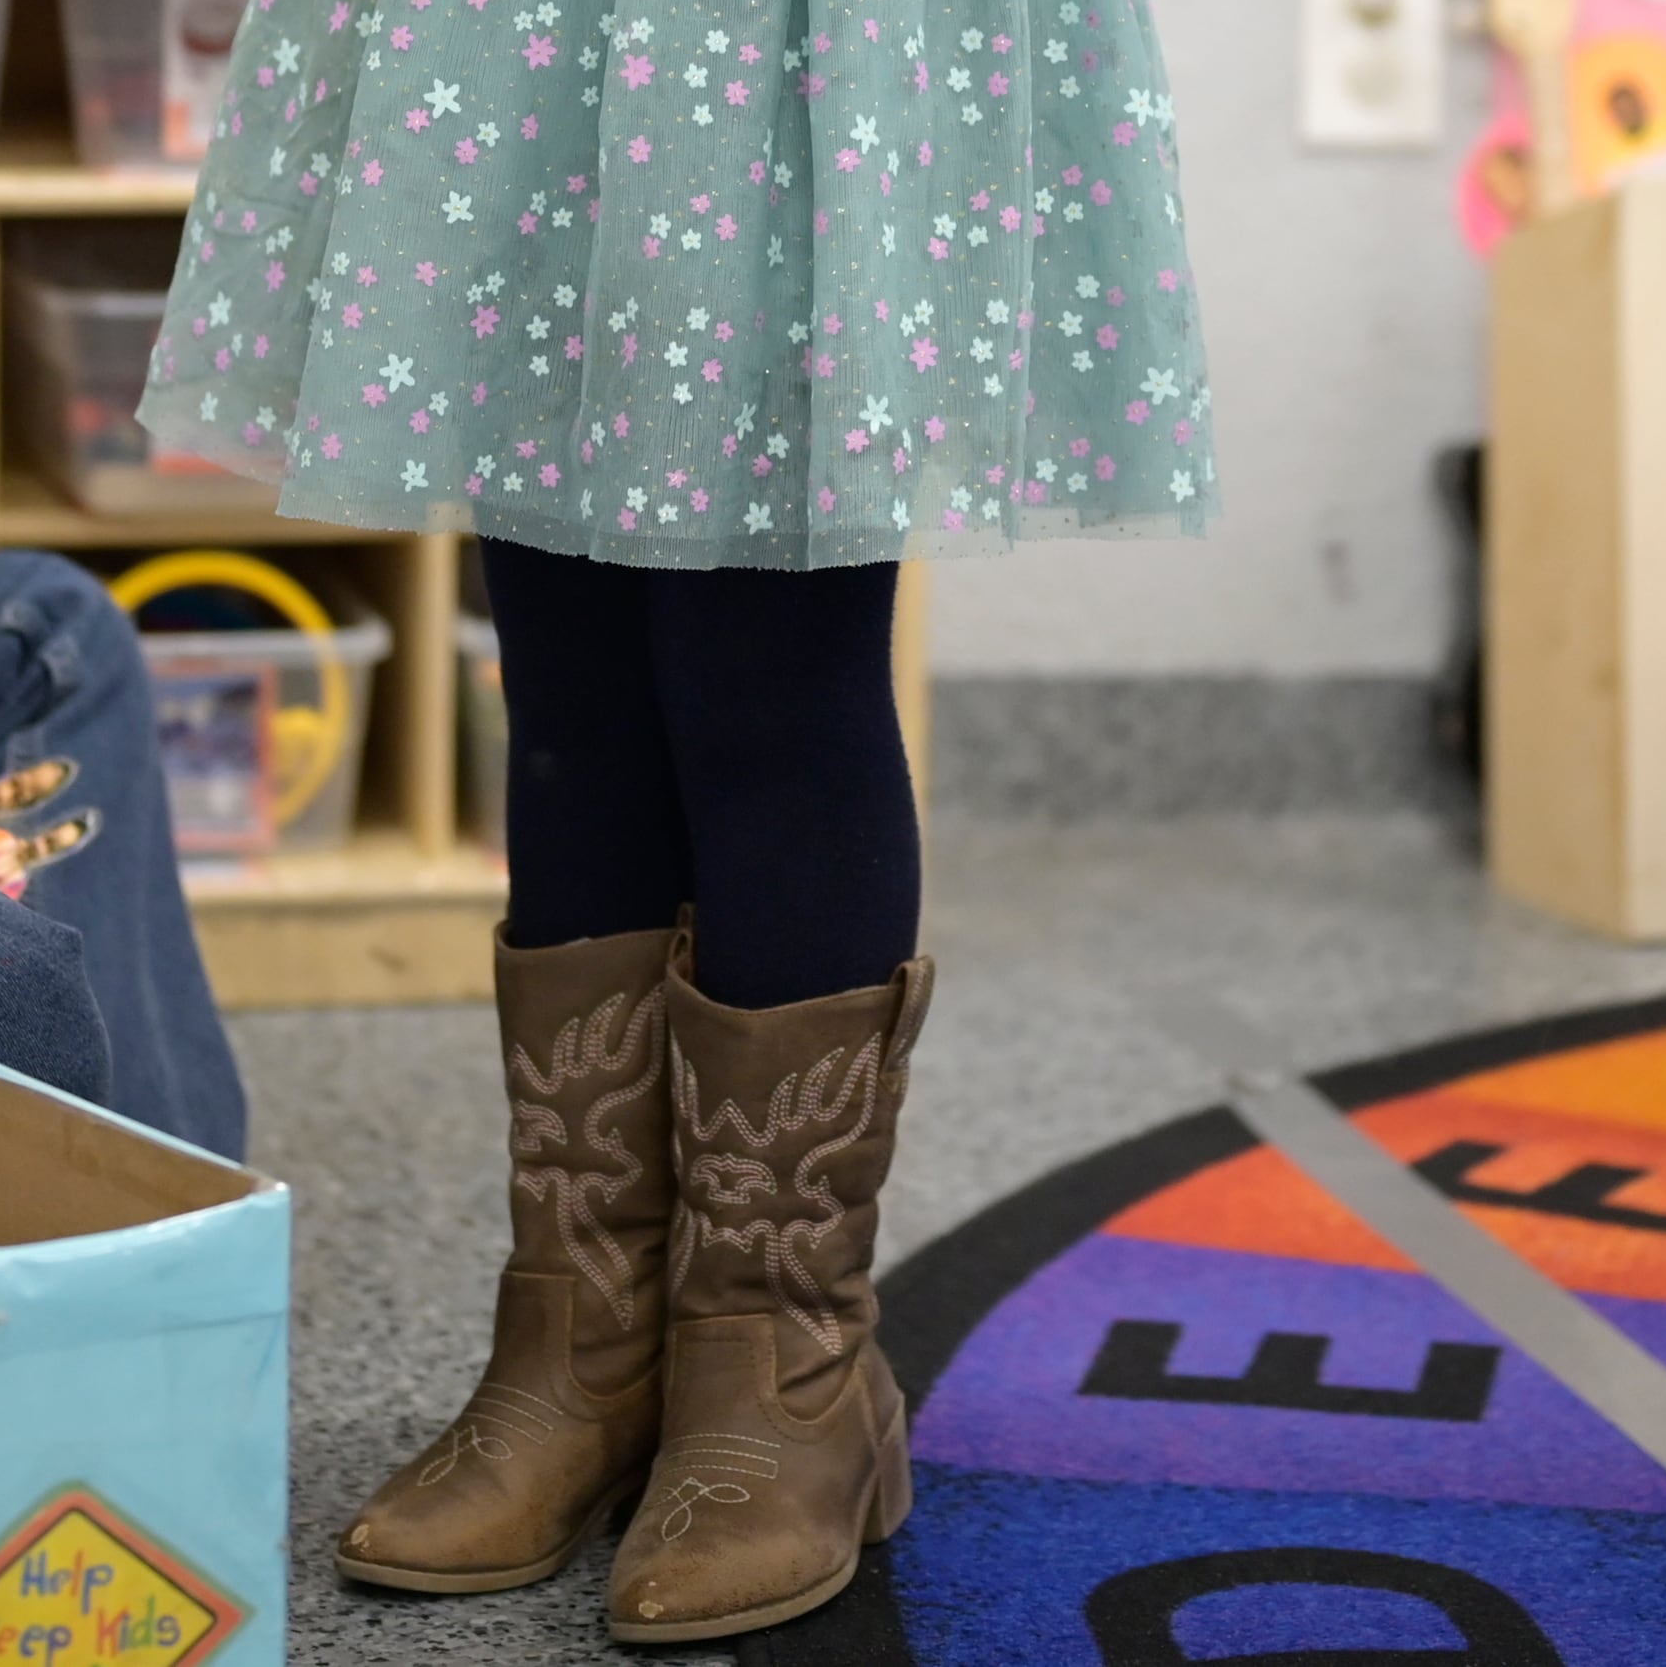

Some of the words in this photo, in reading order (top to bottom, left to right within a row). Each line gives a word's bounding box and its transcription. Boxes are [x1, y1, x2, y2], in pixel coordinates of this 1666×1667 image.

[1077, 1319, 1501, 1423] E
[19, 1547, 114, 1615] Help
[96, 1594, 181, 1658] Kids
